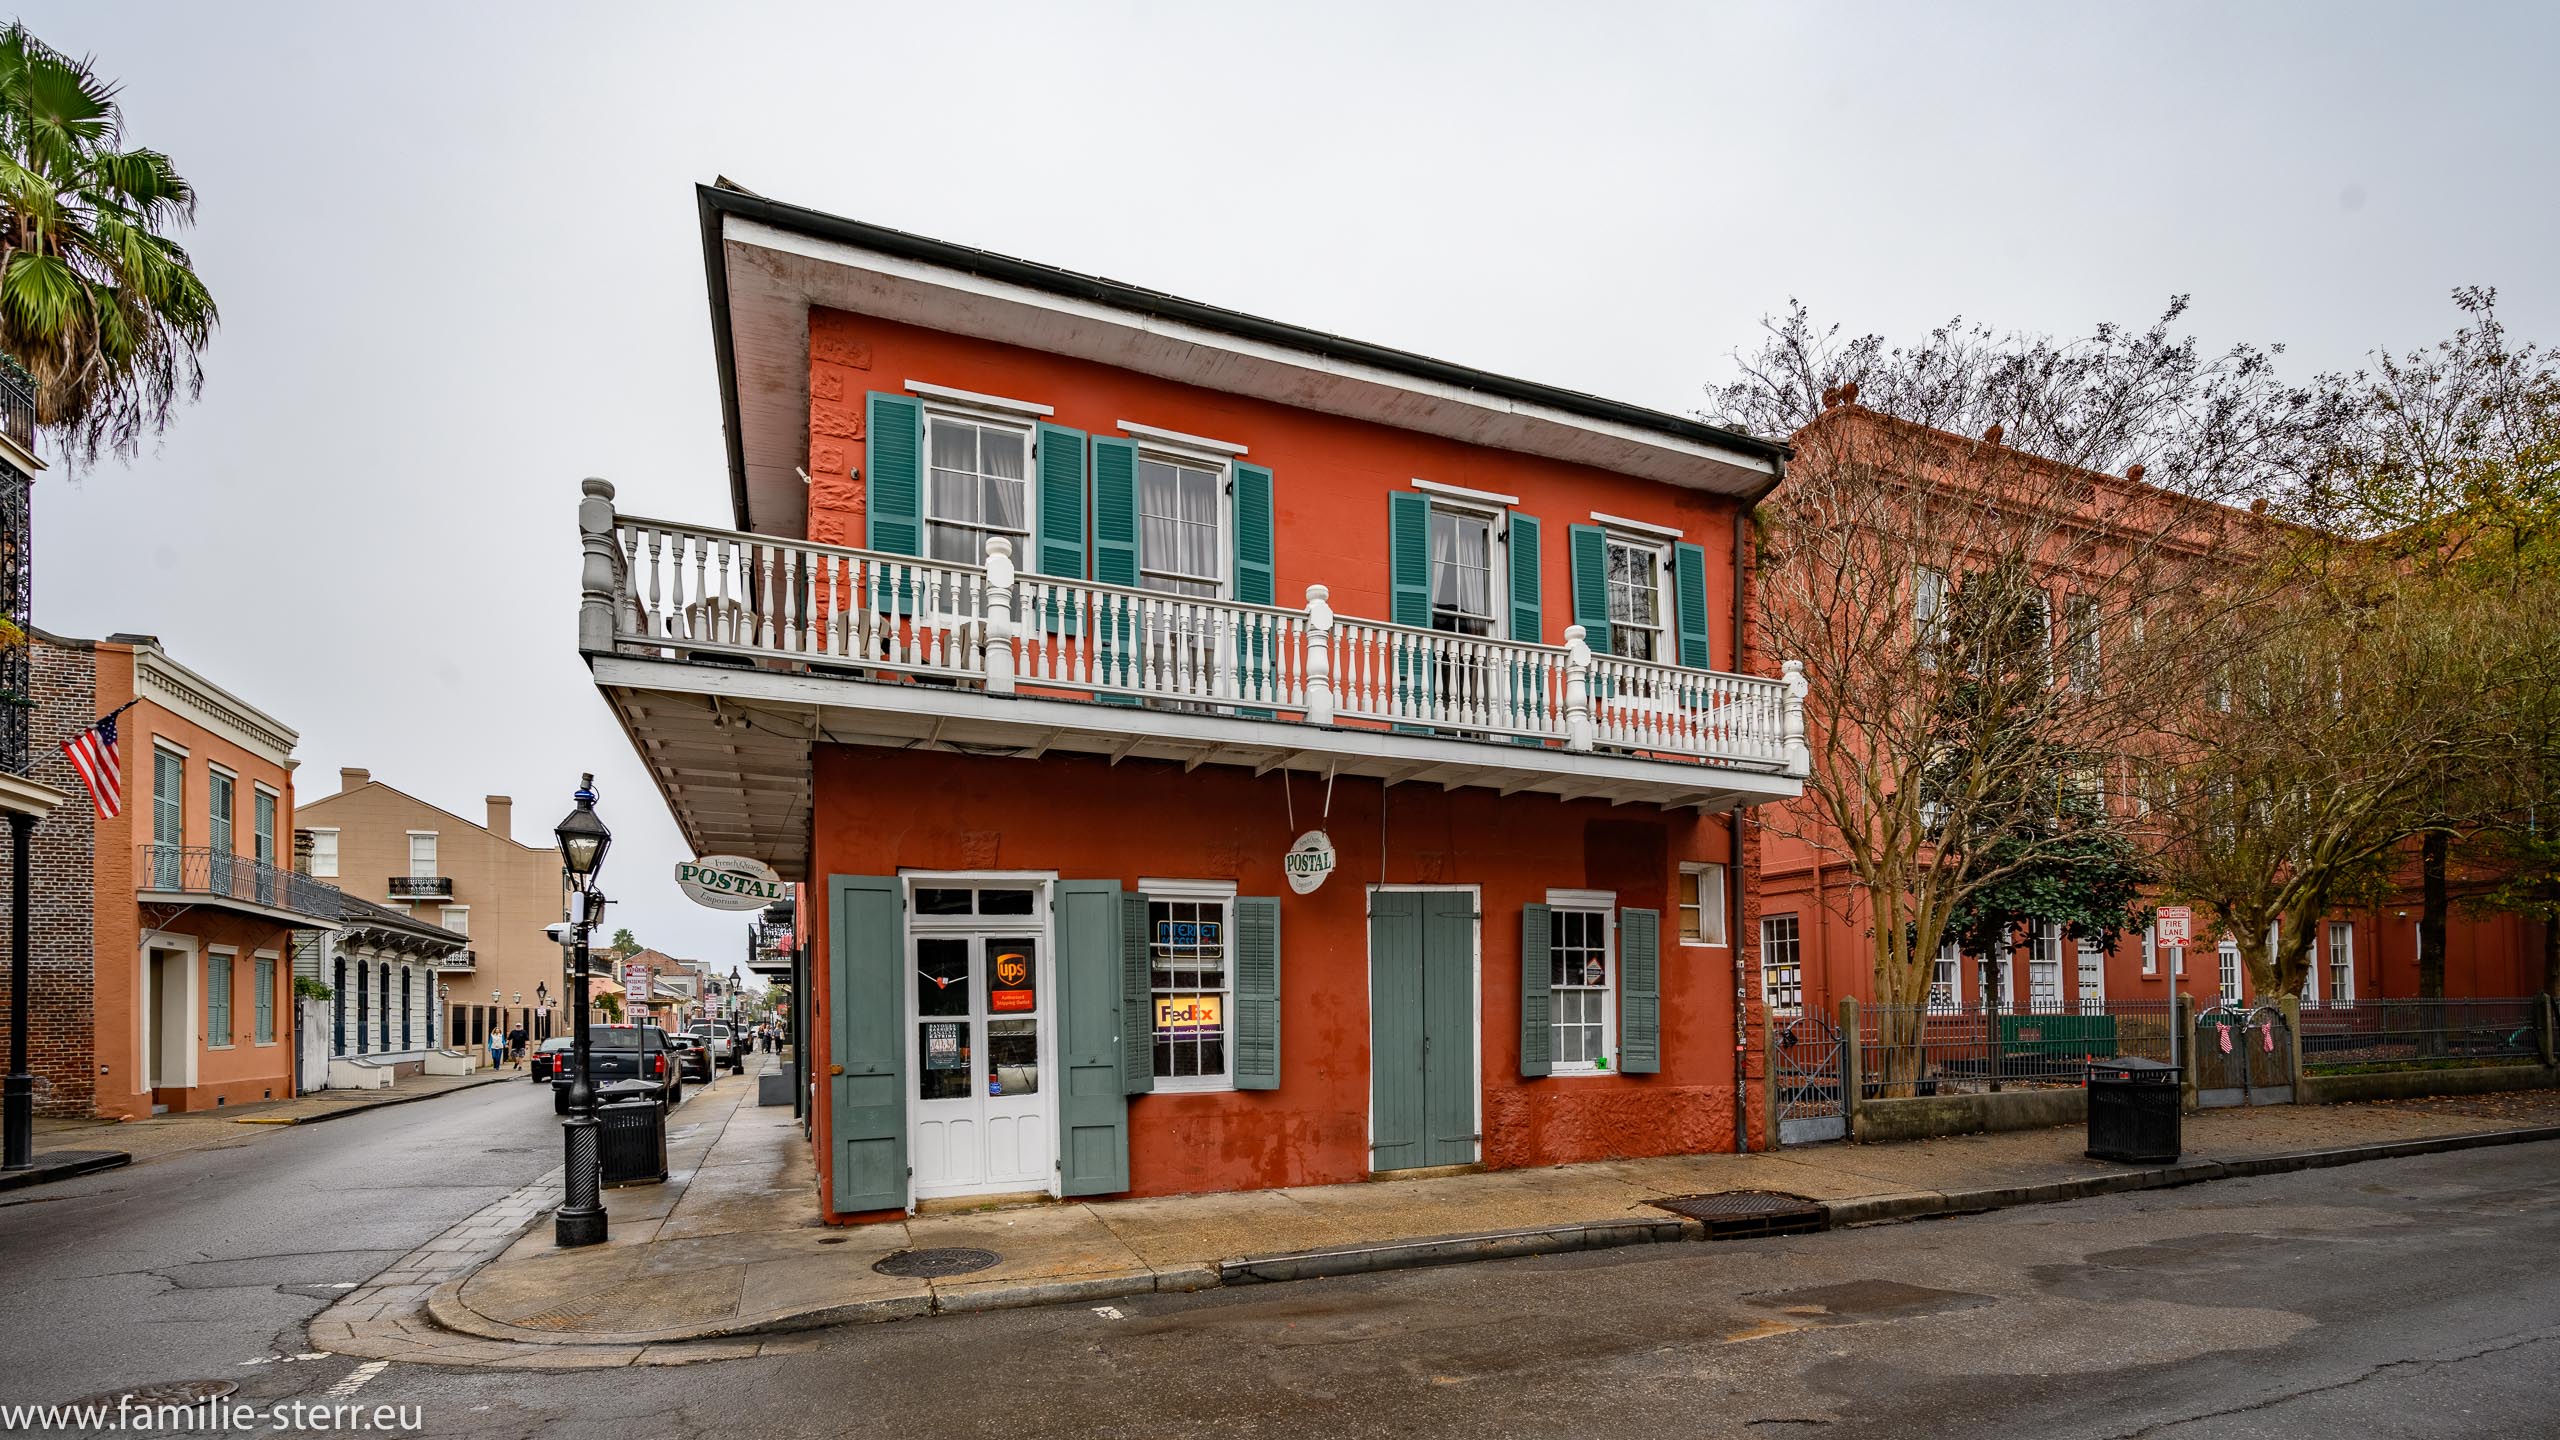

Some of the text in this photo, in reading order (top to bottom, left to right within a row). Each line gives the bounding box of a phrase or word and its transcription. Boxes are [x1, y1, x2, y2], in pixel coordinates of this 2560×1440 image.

[715, 859, 765, 875] French Quarter
[1286, 851, 1332, 872] POSTAL
[680, 864, 782, 899] POSTAL
[700, 891, 739, 905] Emporium
[2159, 909, 2169, 917] NO
[1161, 923, 1217, 937] INTERNET
[1000, 963, 1024, 981] ups
[1161, 1004, 1213, 1022] FedEx
